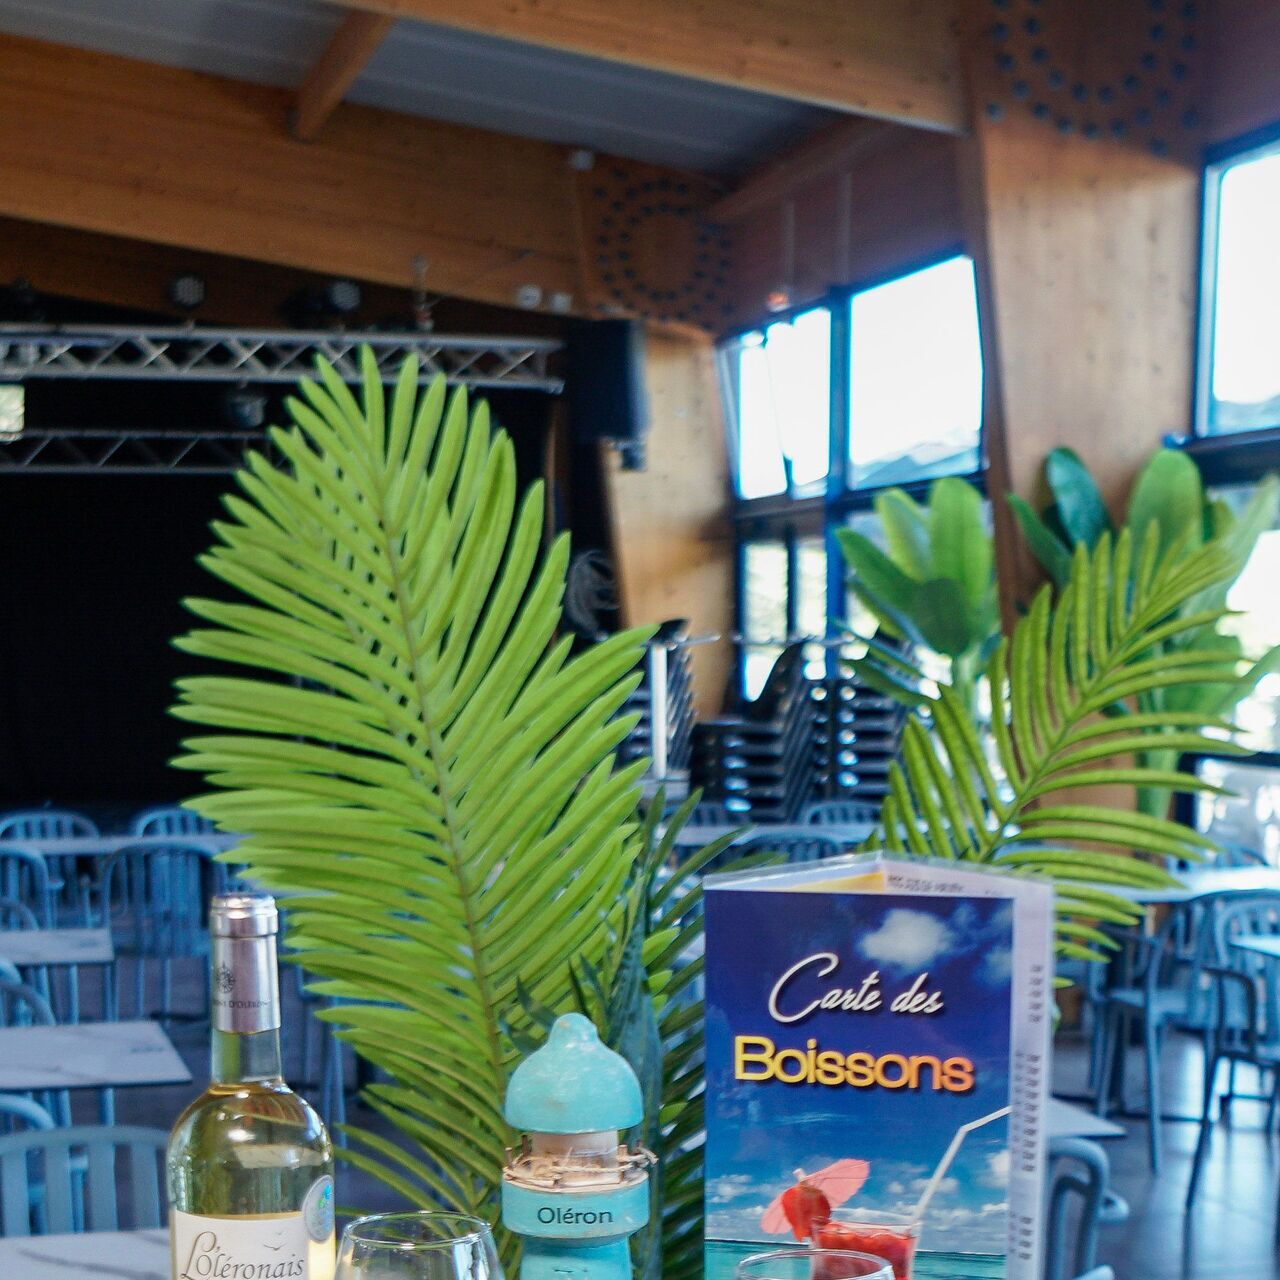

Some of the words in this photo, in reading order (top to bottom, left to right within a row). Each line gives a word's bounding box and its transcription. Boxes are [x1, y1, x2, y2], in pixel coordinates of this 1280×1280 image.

[767, 951, 883, 1024] Carte
[889, 971, 945, 1015] des
[733, 1034, 977, 1092] Boissons
[536, 1206, 615, 1225] Oléron
